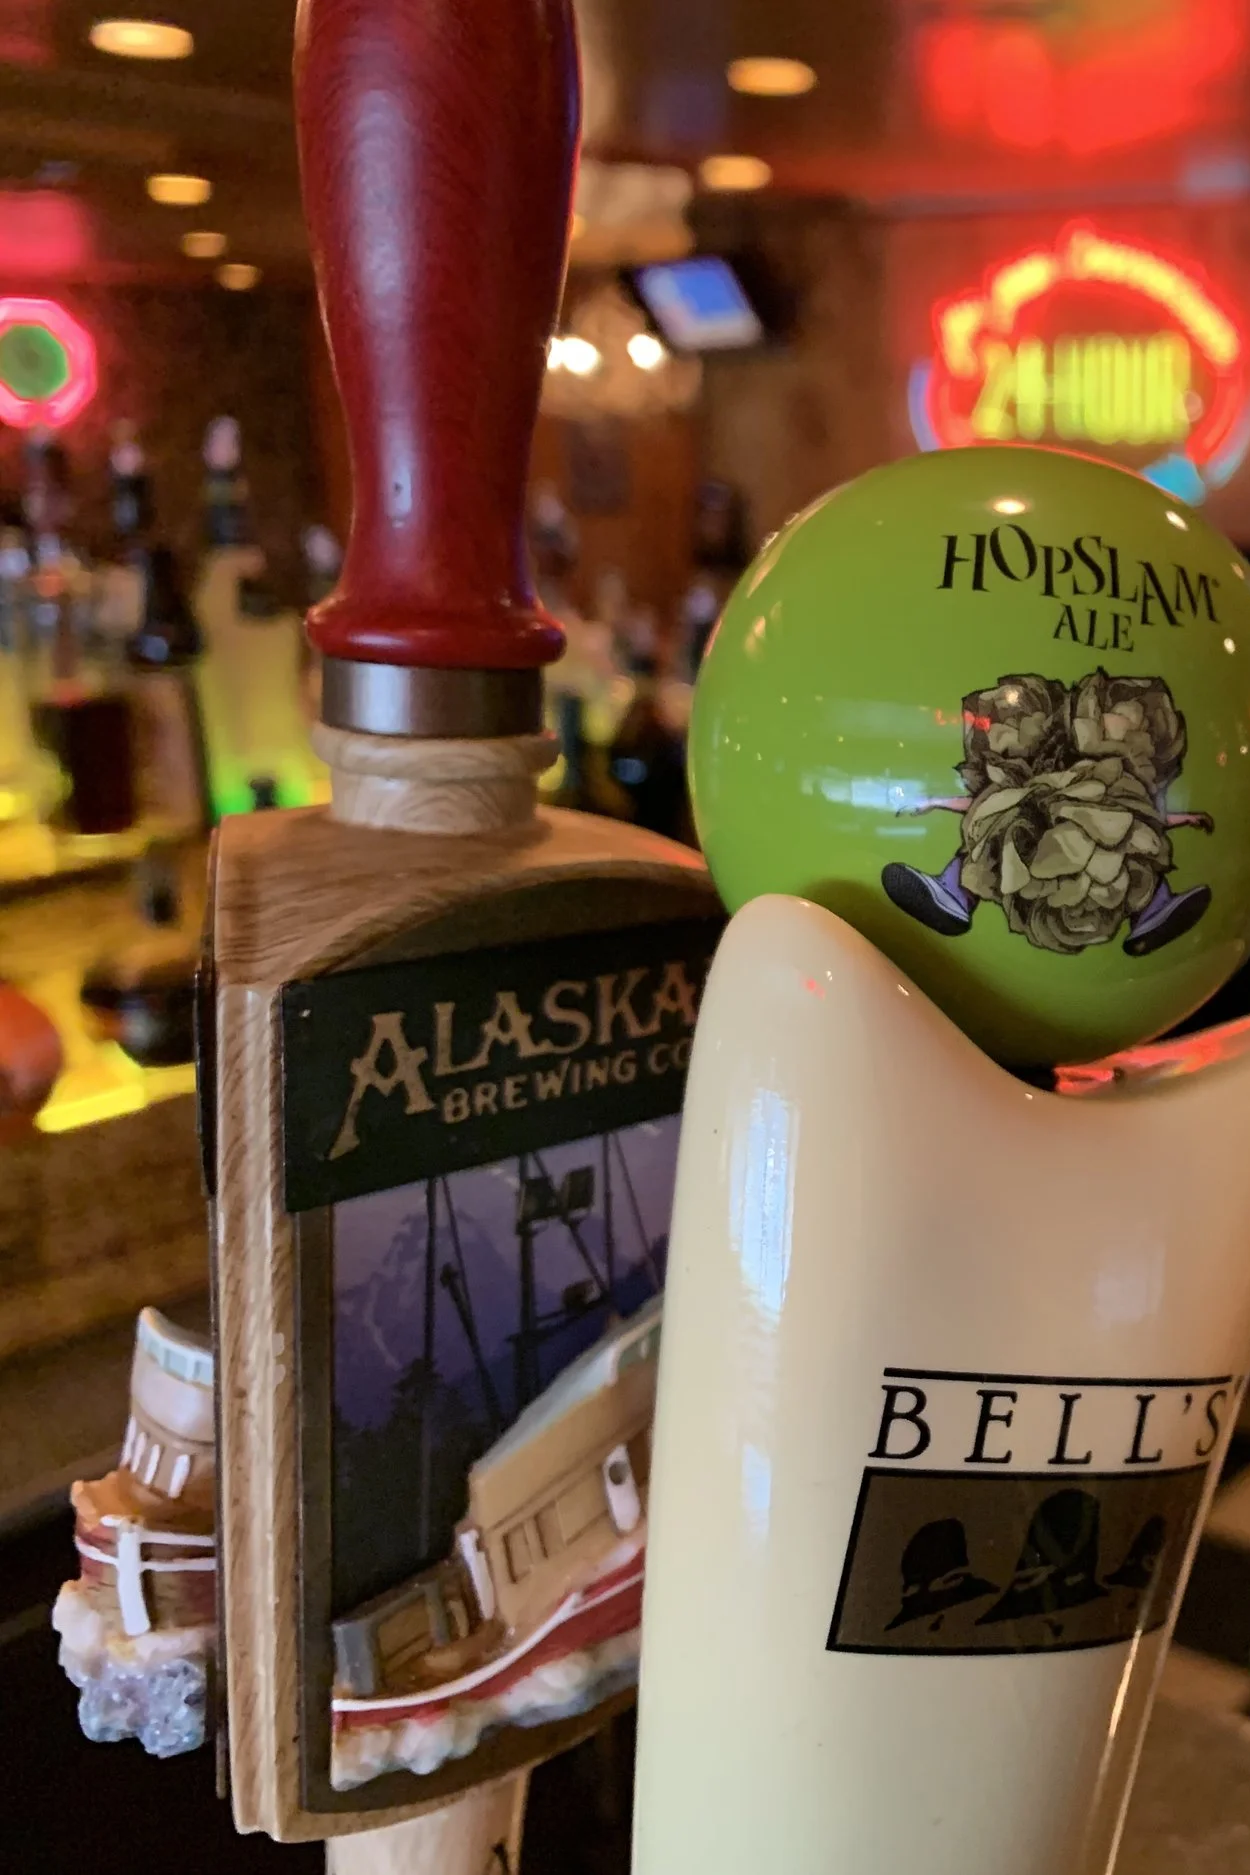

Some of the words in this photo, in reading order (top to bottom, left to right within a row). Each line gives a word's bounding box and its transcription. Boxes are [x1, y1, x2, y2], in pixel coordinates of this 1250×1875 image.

[936, 523, 1220, 627] HOPSLAM
[1052, 603, 1135, 653] ALE
[322, 956, 714, 1161] ALASKA
[440, 1050, 637, 1125] BREWING
[868, 1384, 1228, 1465] BELL'S
